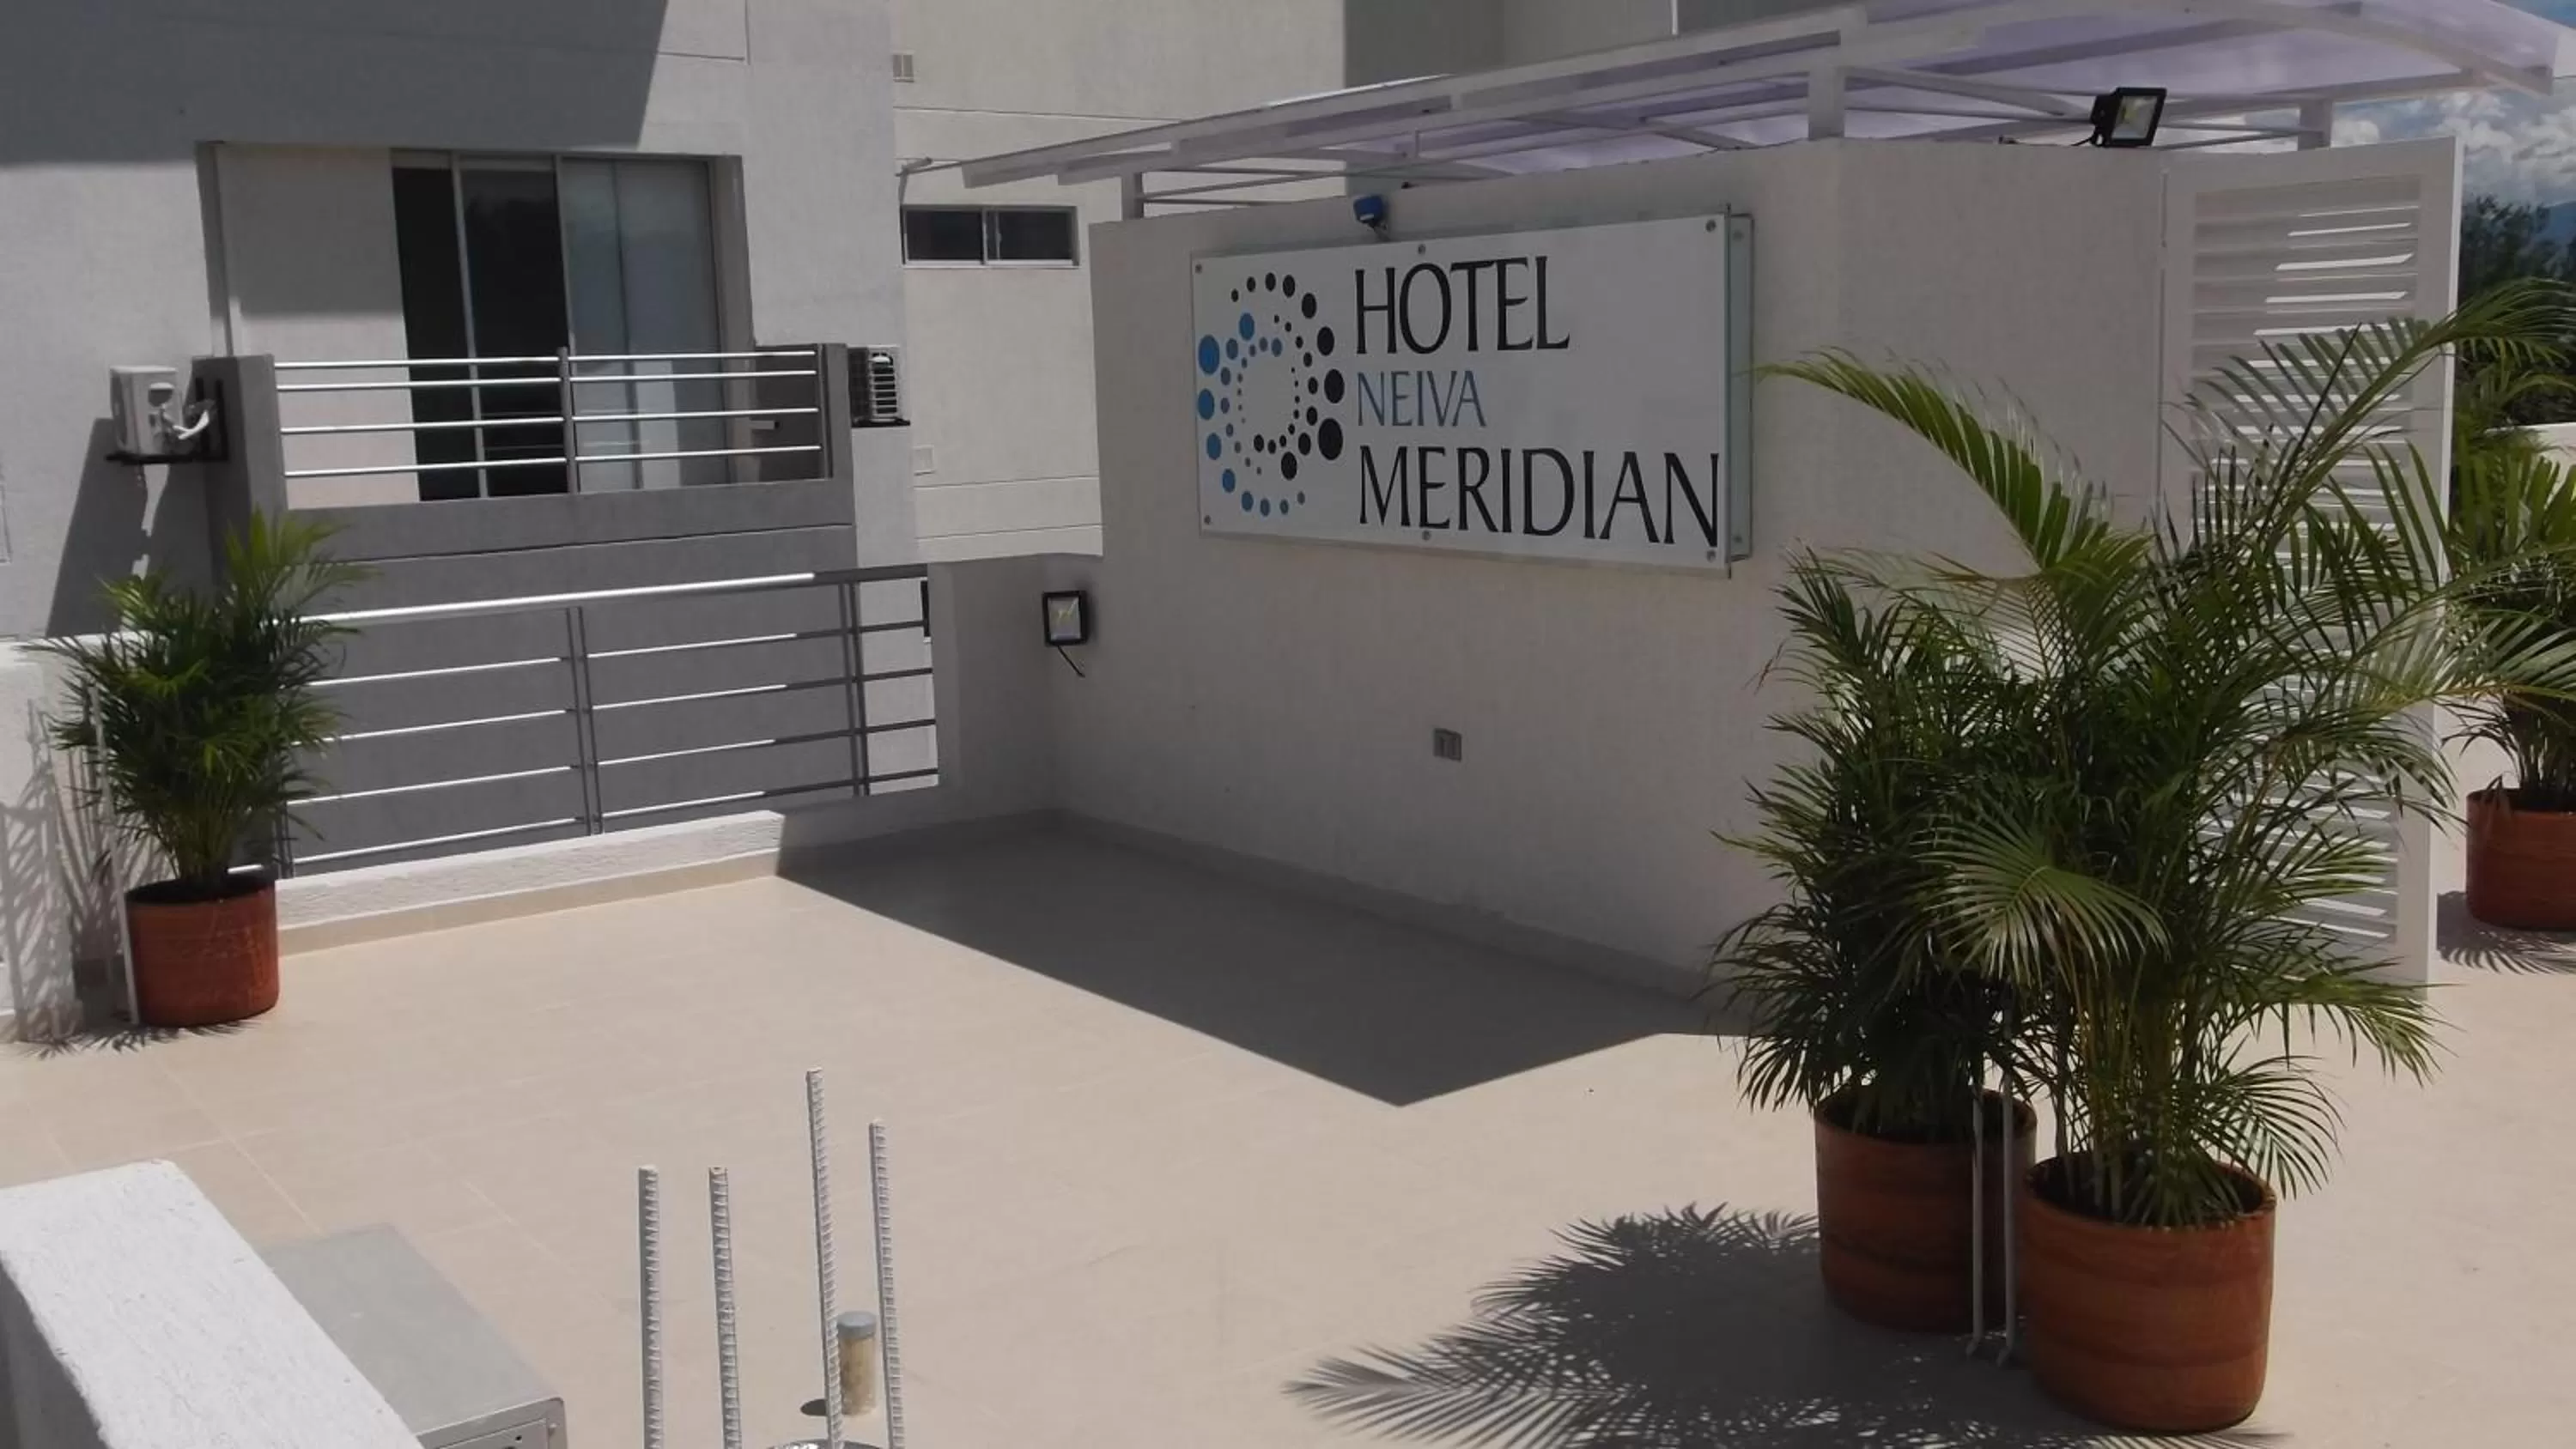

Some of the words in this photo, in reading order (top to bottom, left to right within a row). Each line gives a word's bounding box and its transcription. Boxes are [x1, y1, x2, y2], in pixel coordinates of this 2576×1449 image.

[1355, 256, 1570, 355] HOTEL
[1357, 370, 1487, 427] NEIVA
[1359, 446, 1719, 548] MERIDIAN
